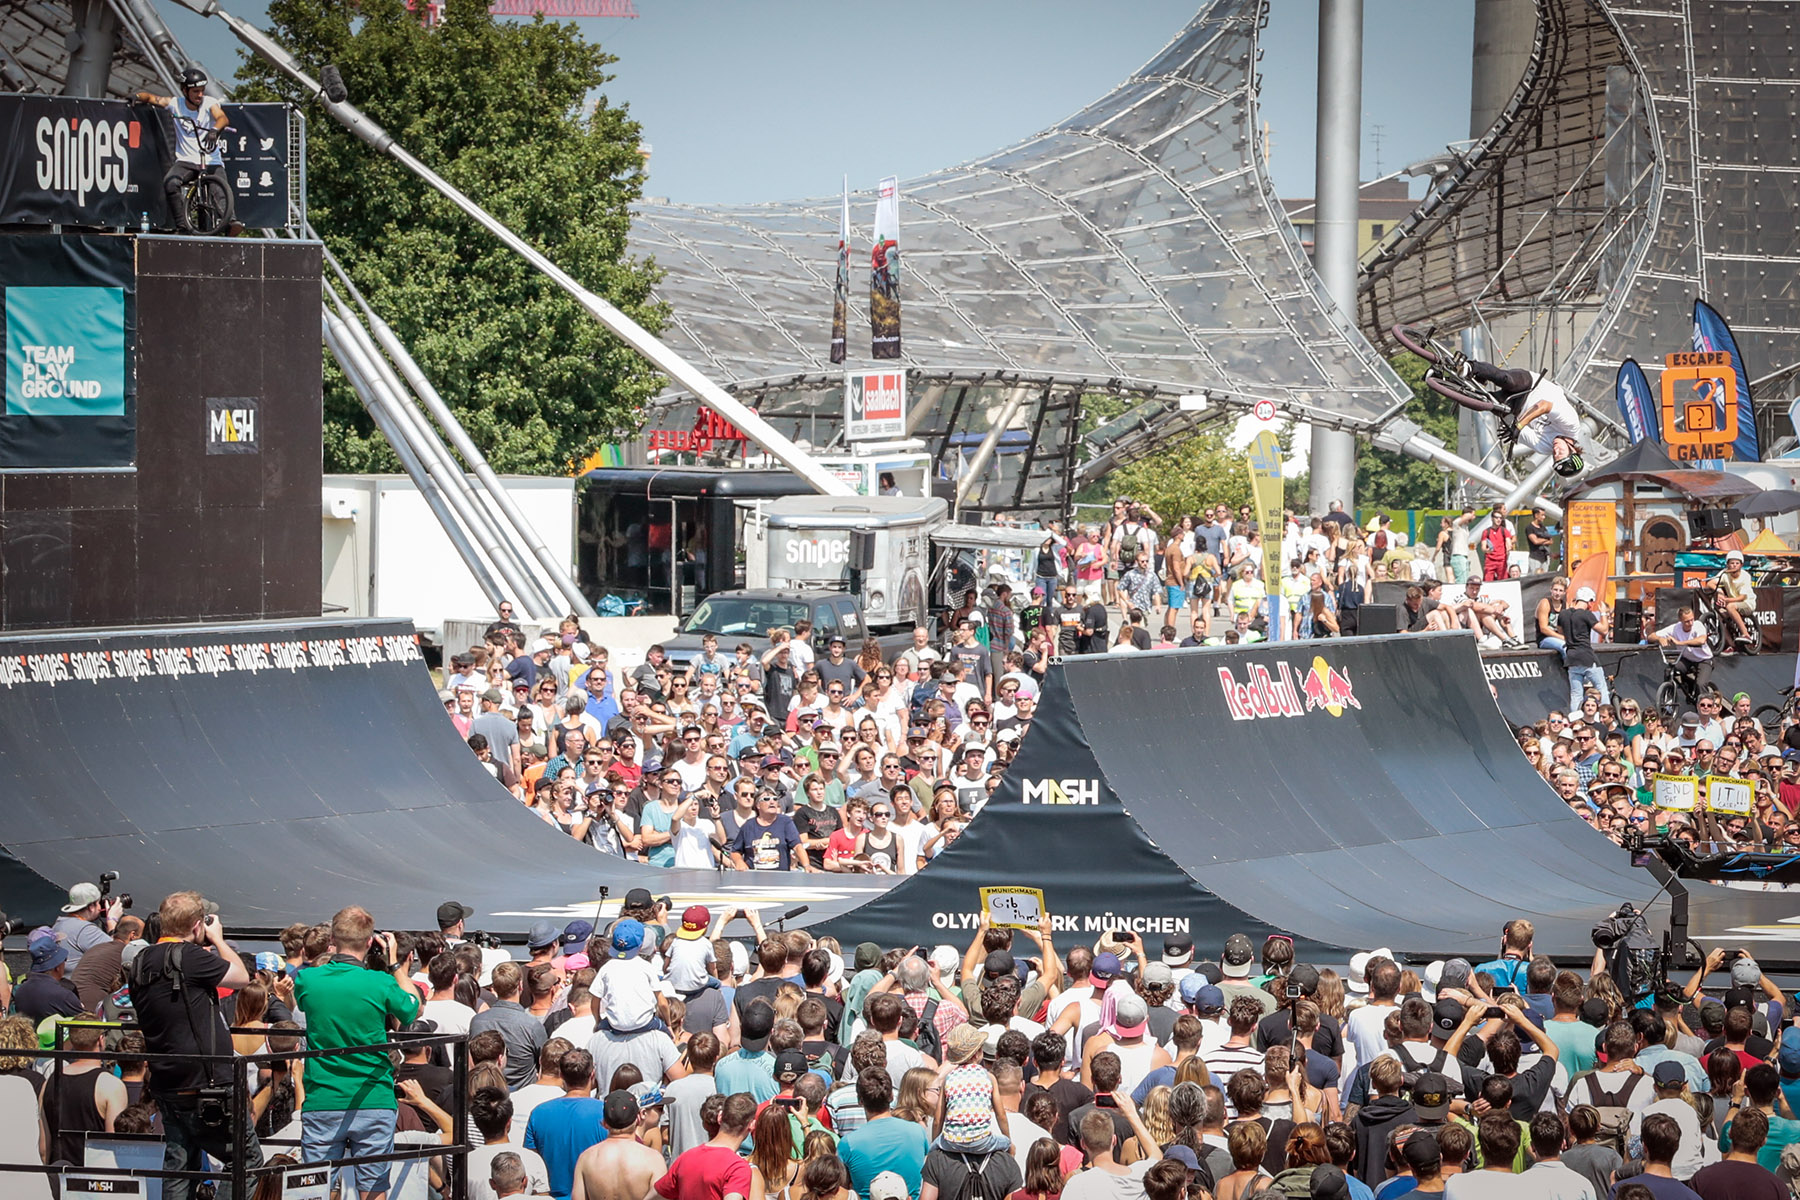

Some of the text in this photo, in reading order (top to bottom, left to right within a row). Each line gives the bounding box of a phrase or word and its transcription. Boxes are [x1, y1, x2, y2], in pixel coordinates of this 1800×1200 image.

[36, 116, 129, 207] snipes
[22, 345, 75, 364] TEAM
[1672, 352, 1724, 366] ESCAPE
[22, 363, 69, 381] PLAY
[21, 380, 102, 399] GROUND
[210, 409, 254, 443] MASH
[1677, 443, 1726, 461] GAME
[28, 654, 69, 687] snipes
[70, 651, 111, 685] snipes
[112, 649, 151, 682] snipes
[152, 648, 192, 680] snipes
[192, 645, 231, 678] snipes
[231, 643, 270, 675] snipes
[270, 641, 308, 674] snipes
[308, 639, 346, 671] snipes
[346, 637, 382, 669] snipes
[382, 635, 420, 667] snipes
[1217, 661, 1305, 720] Red Bull
[1022, 779, 1098, 805] MASH
[986, 887, 1038, 895] #MUNICHMASH
[993, 896, 1018, 908] Gib
[1084, 912, 1190, 934] MÜNCHEN
[88, 1181, 113, 1191] MASH
